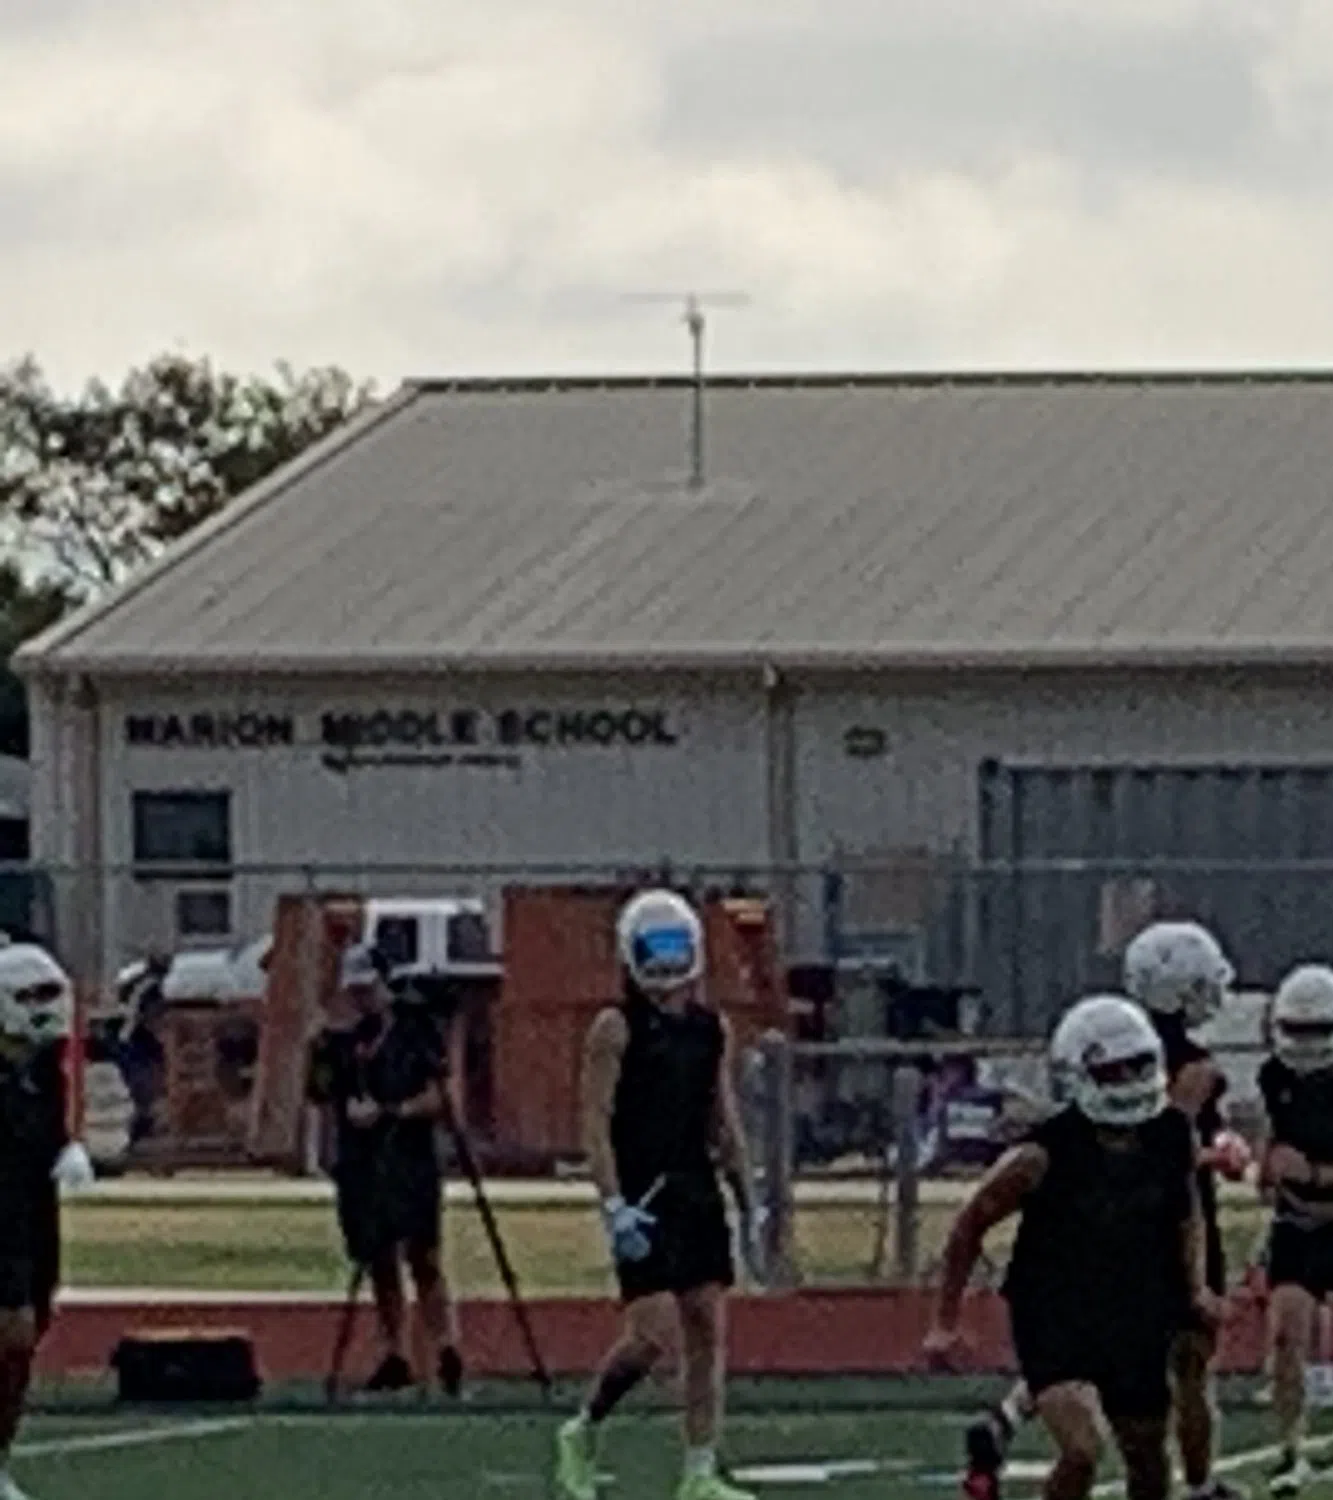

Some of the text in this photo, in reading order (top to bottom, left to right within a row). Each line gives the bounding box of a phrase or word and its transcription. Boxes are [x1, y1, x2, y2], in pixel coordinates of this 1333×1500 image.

[125, 710, 677, 746] MARION MIDDLE SCHOOL
